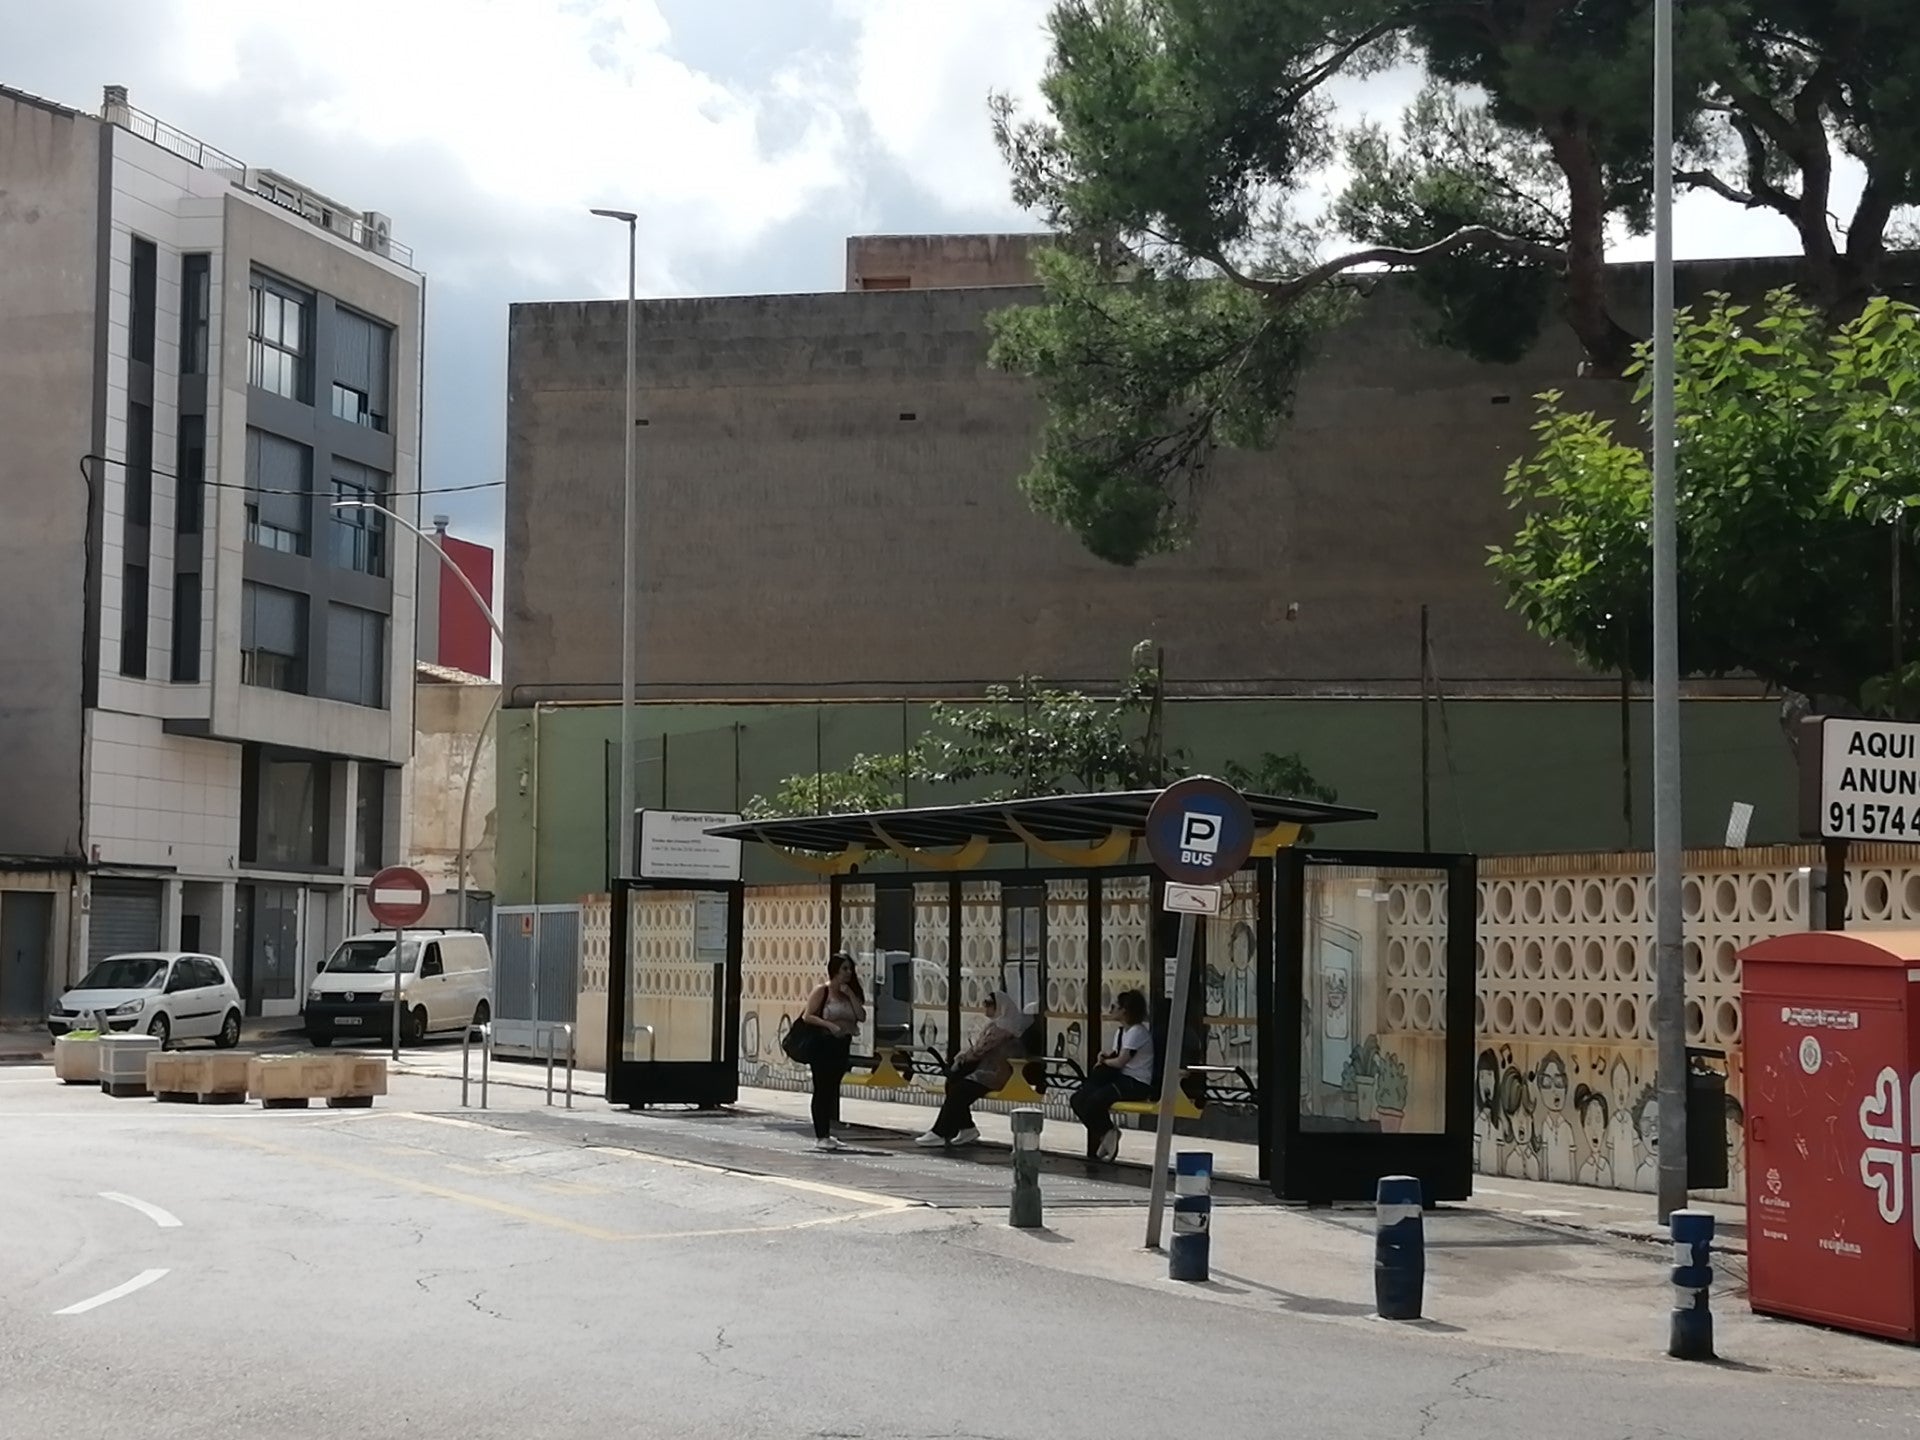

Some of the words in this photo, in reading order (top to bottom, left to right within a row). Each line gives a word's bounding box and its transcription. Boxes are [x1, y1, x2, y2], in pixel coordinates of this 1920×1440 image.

[1848, 731, 1914, 758] AQUI
[1839, 766, 1920, 795] ANUN
[1185, 818, 1215, 845] P
[1181, 850, 1213, 866] BUS
